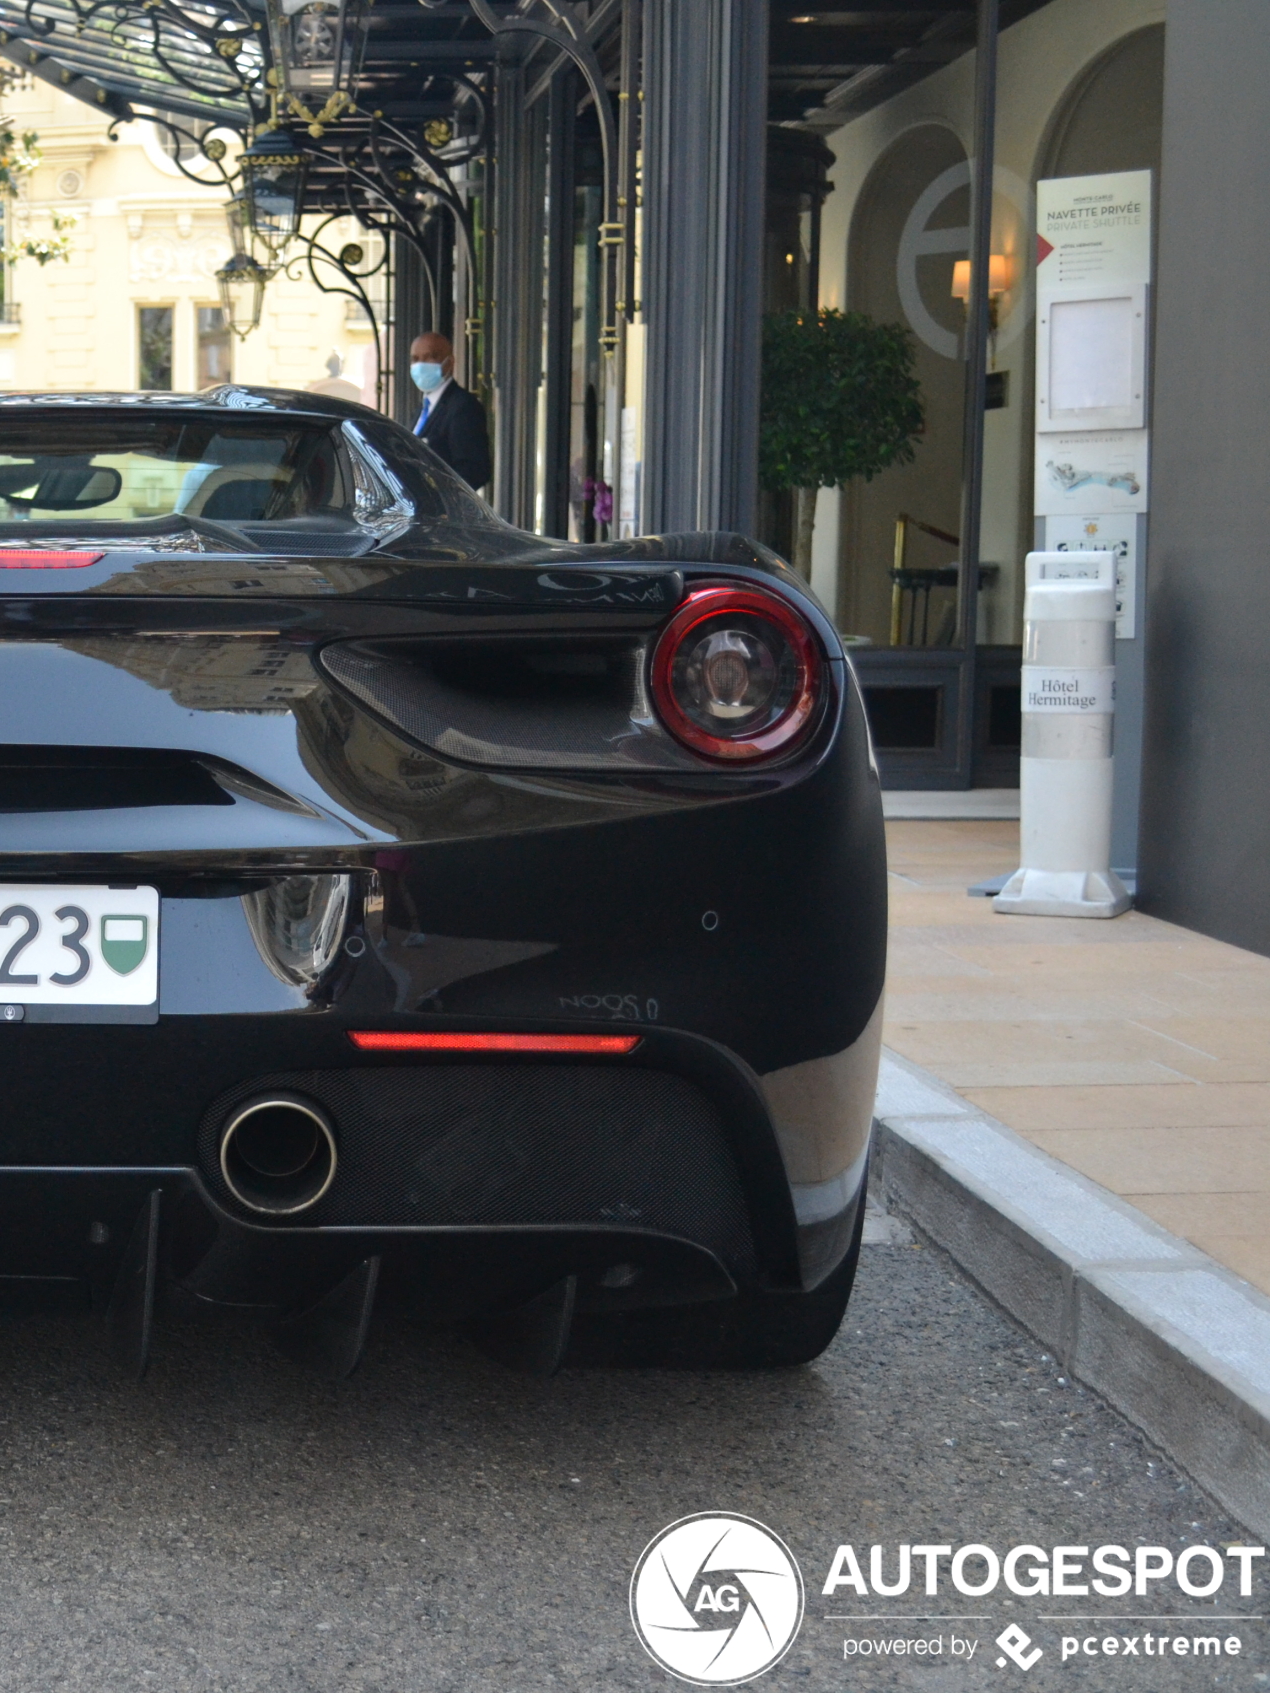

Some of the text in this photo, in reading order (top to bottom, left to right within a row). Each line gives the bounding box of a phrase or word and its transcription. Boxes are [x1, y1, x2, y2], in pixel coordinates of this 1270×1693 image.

[1047, 207, 1097, 221] NAVETTE
[1101, 201, 1141, 215] PRIVÉE
[1047, 215, 1141, 232] PRIVATE SHUTTLE
[1042, 680, 1079, 692] Hôtel
[1028, 692, 1096, 709] Hermitage
